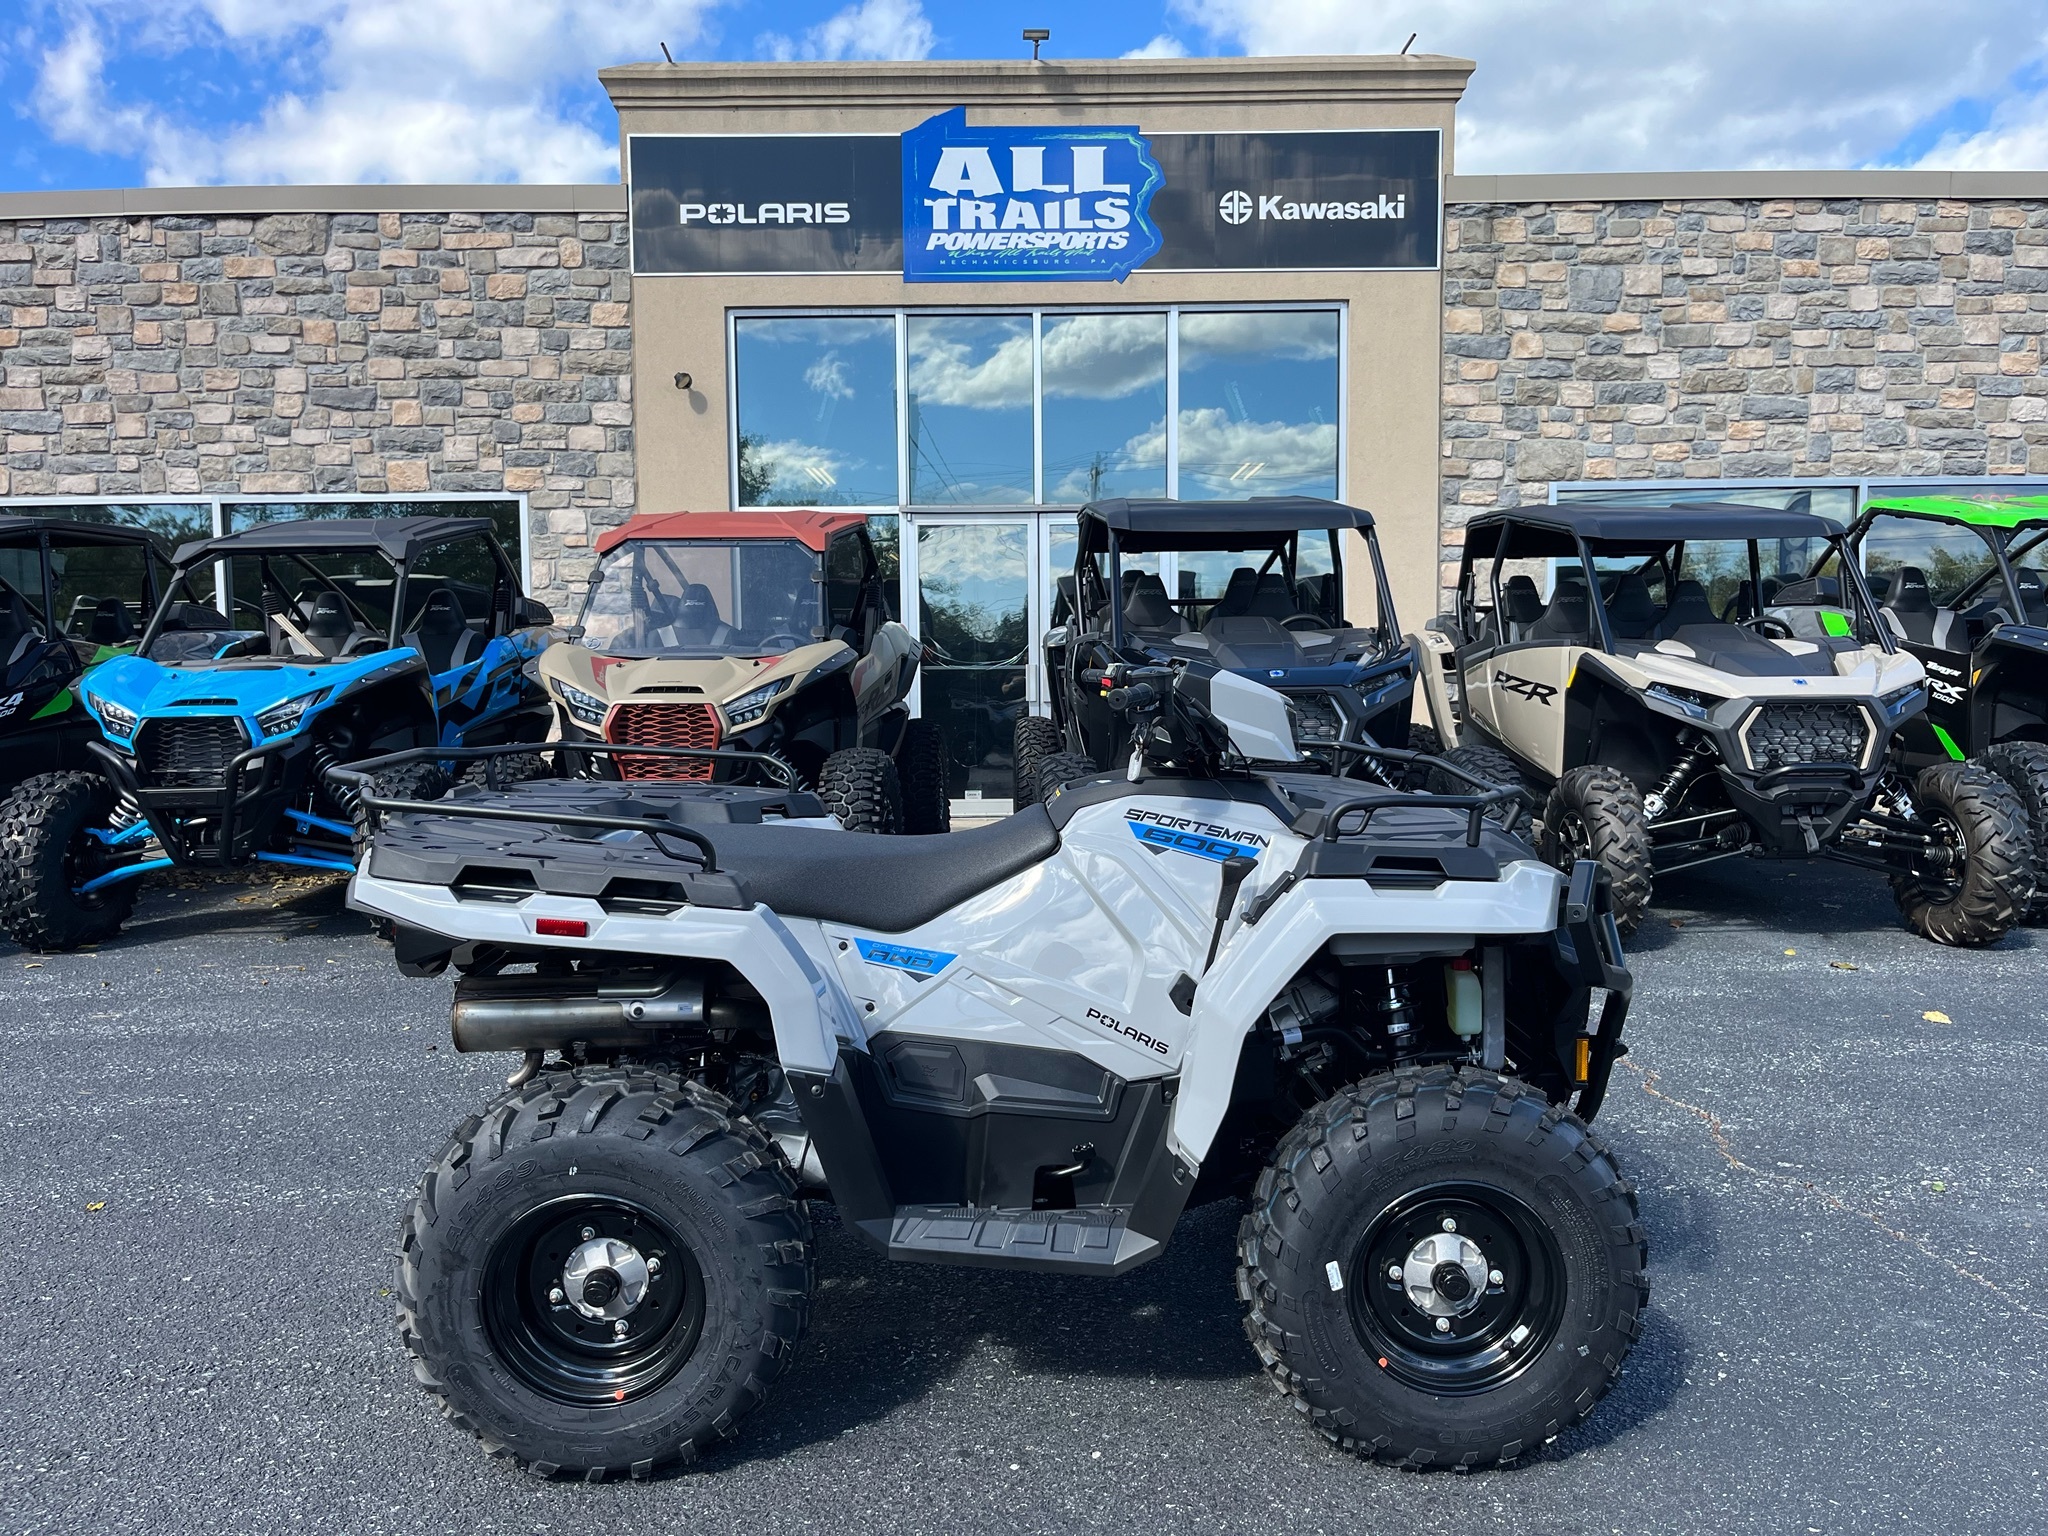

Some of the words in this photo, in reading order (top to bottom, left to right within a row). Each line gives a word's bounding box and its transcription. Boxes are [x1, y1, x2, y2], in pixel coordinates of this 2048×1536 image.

[929, 146, 1131, 198] ALL
[680, 203, 850, 224] POLARIS
[924, 197, 1131, 230] TRAILS
[1258, 194, 1405, 220] Kawasaki
[926, 231, 1130, 251] POWERSPORTS
[1494, 669, 1558, 706] RZR
[1925, 674, 1968, 701] RX
[1931, 691, 1957, 705] 1000
[1123, 808, 1272, 848] SPORTSMAN
[1142, 827, 1240, 858] 600
[867, 949, 934, 969] AWD
[891, 946, 938, 958] DEMAND
[1086, 1007, 1169, 1055] POLARIS
